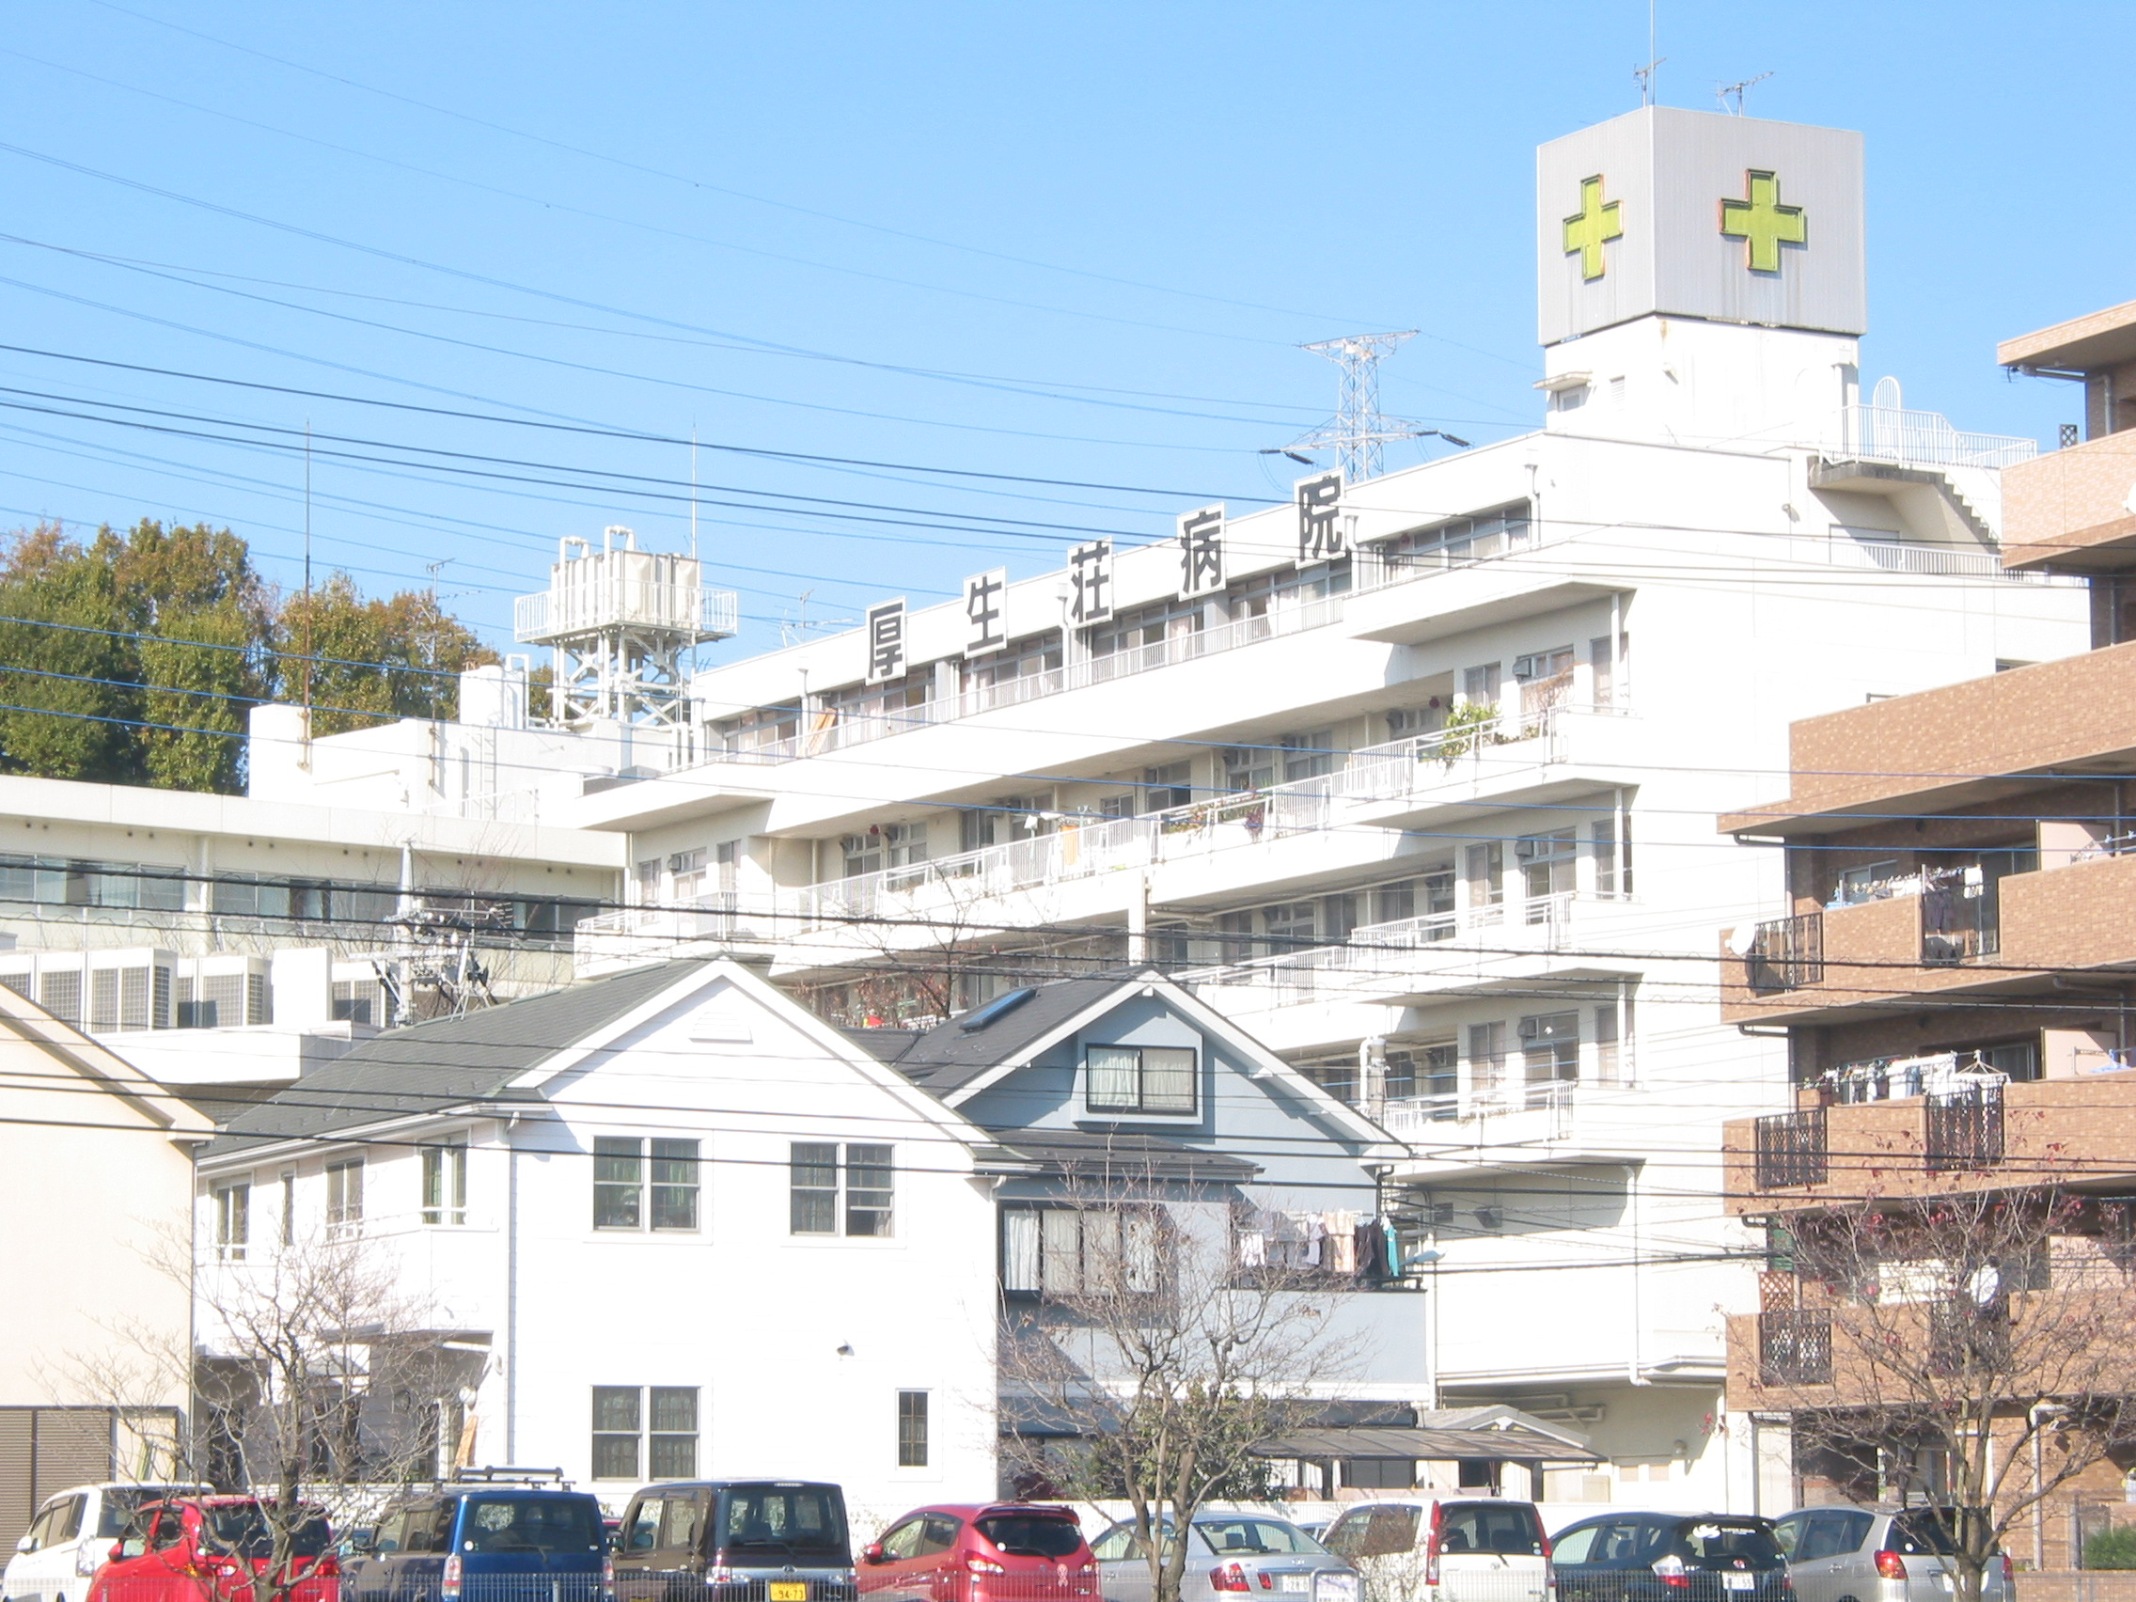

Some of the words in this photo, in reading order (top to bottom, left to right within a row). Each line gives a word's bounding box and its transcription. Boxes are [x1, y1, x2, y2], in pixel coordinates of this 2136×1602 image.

[868, 475, 1343, 679] 厚生荘病院
